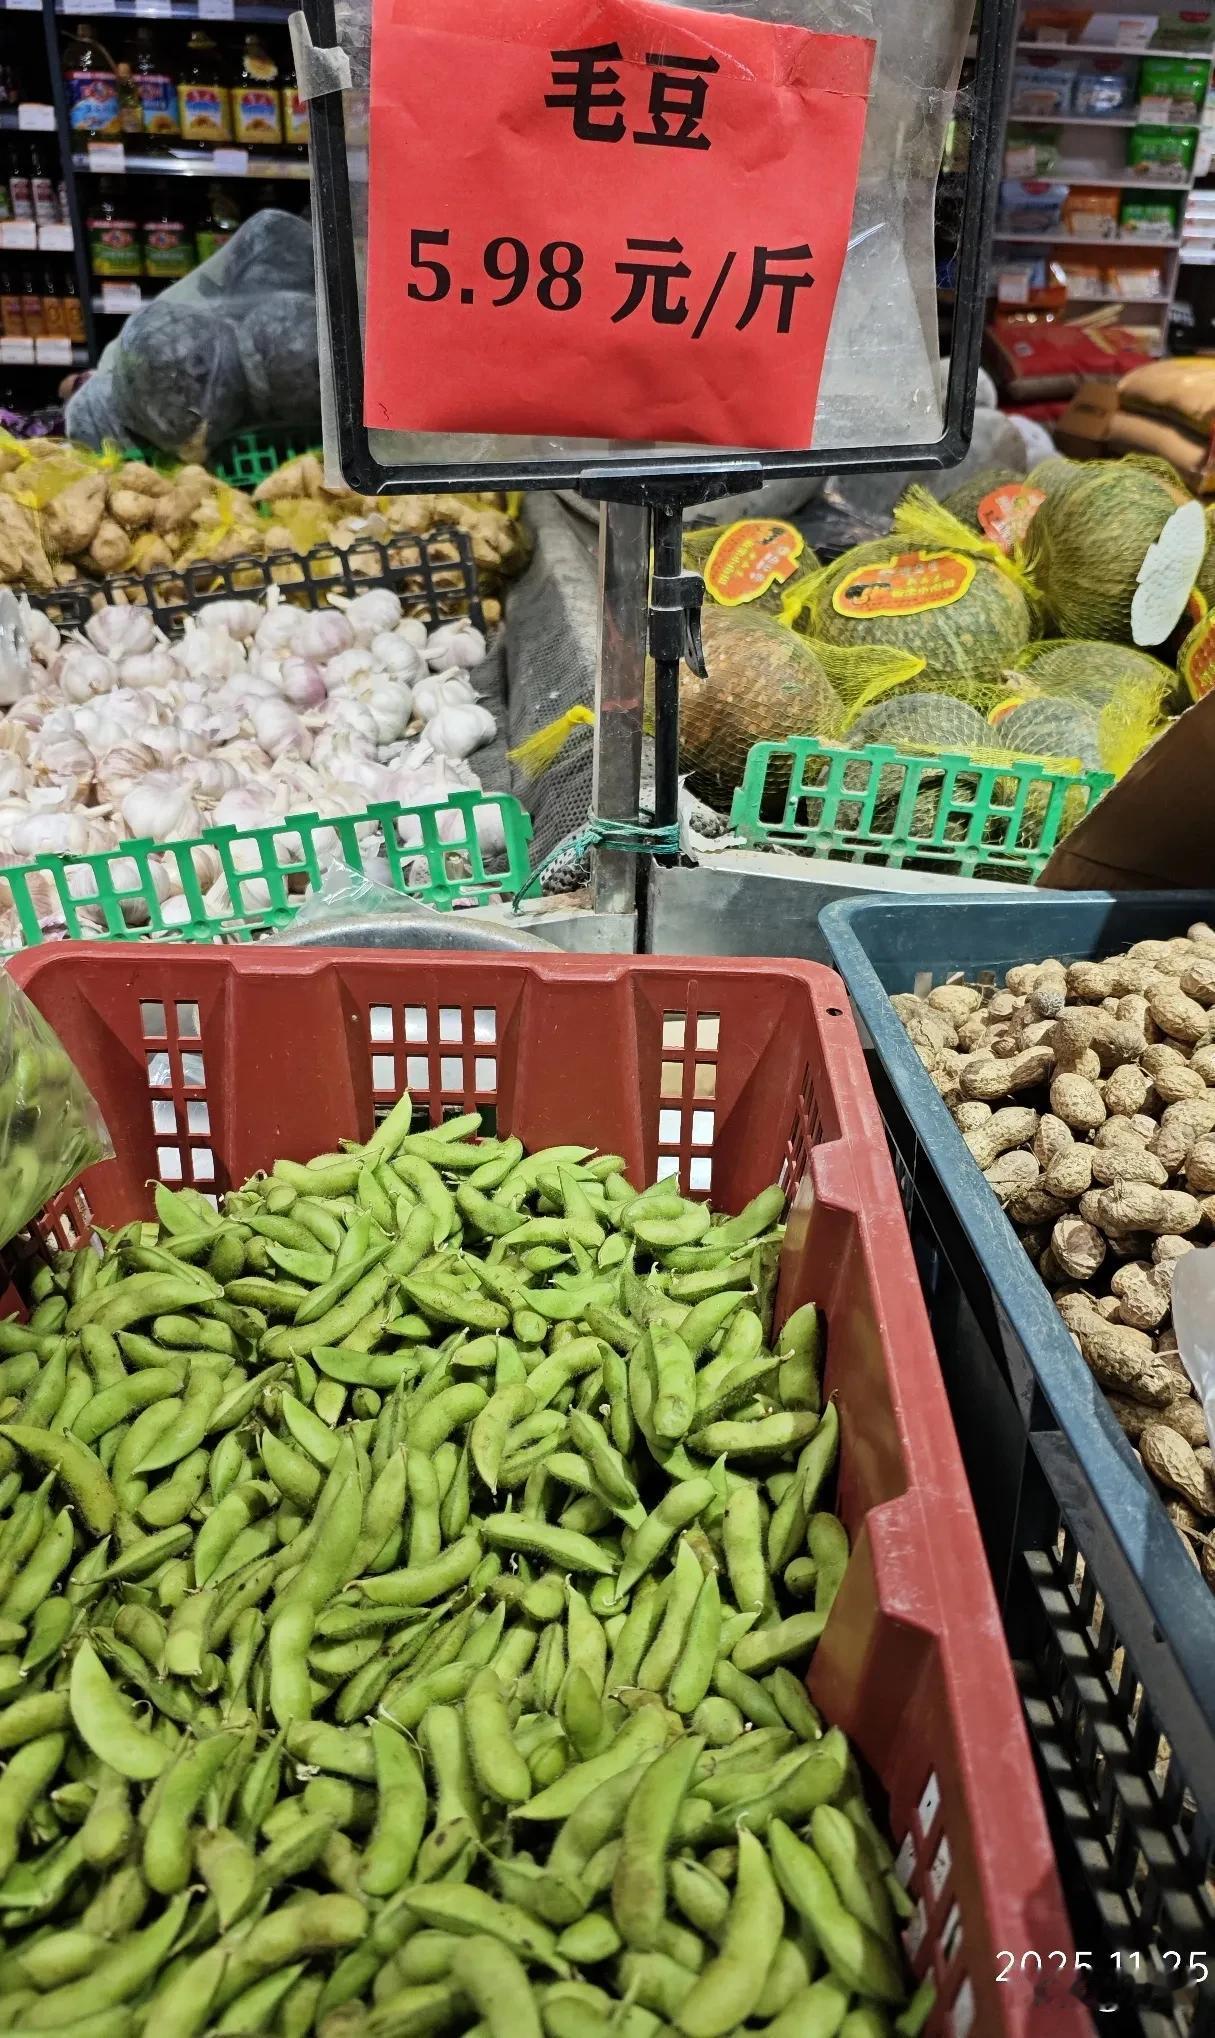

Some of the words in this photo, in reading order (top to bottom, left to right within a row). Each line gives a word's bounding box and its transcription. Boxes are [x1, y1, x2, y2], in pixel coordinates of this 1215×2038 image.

[543, 41, 721, 151] 毛豆
[407, 228, 584, 311] 5.98
[610, 237, 815, 339] 元/斤
